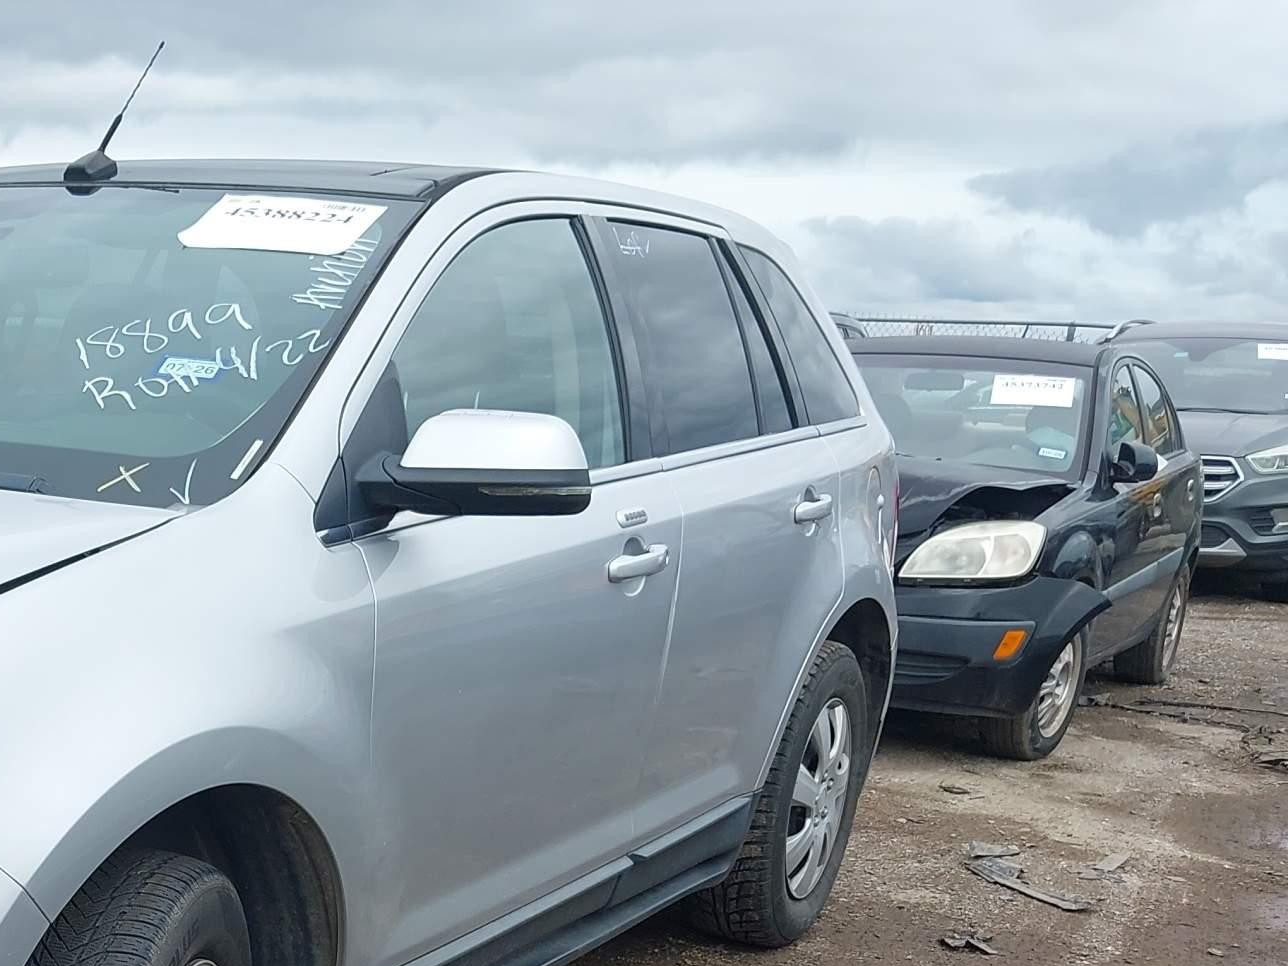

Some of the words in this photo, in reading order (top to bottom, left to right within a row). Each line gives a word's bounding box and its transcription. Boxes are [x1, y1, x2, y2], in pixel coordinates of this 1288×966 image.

[224, 206, 354, 224] 45388224
[76, 303, 253, 369] 18899
[194, 365, 216, 375] 26
